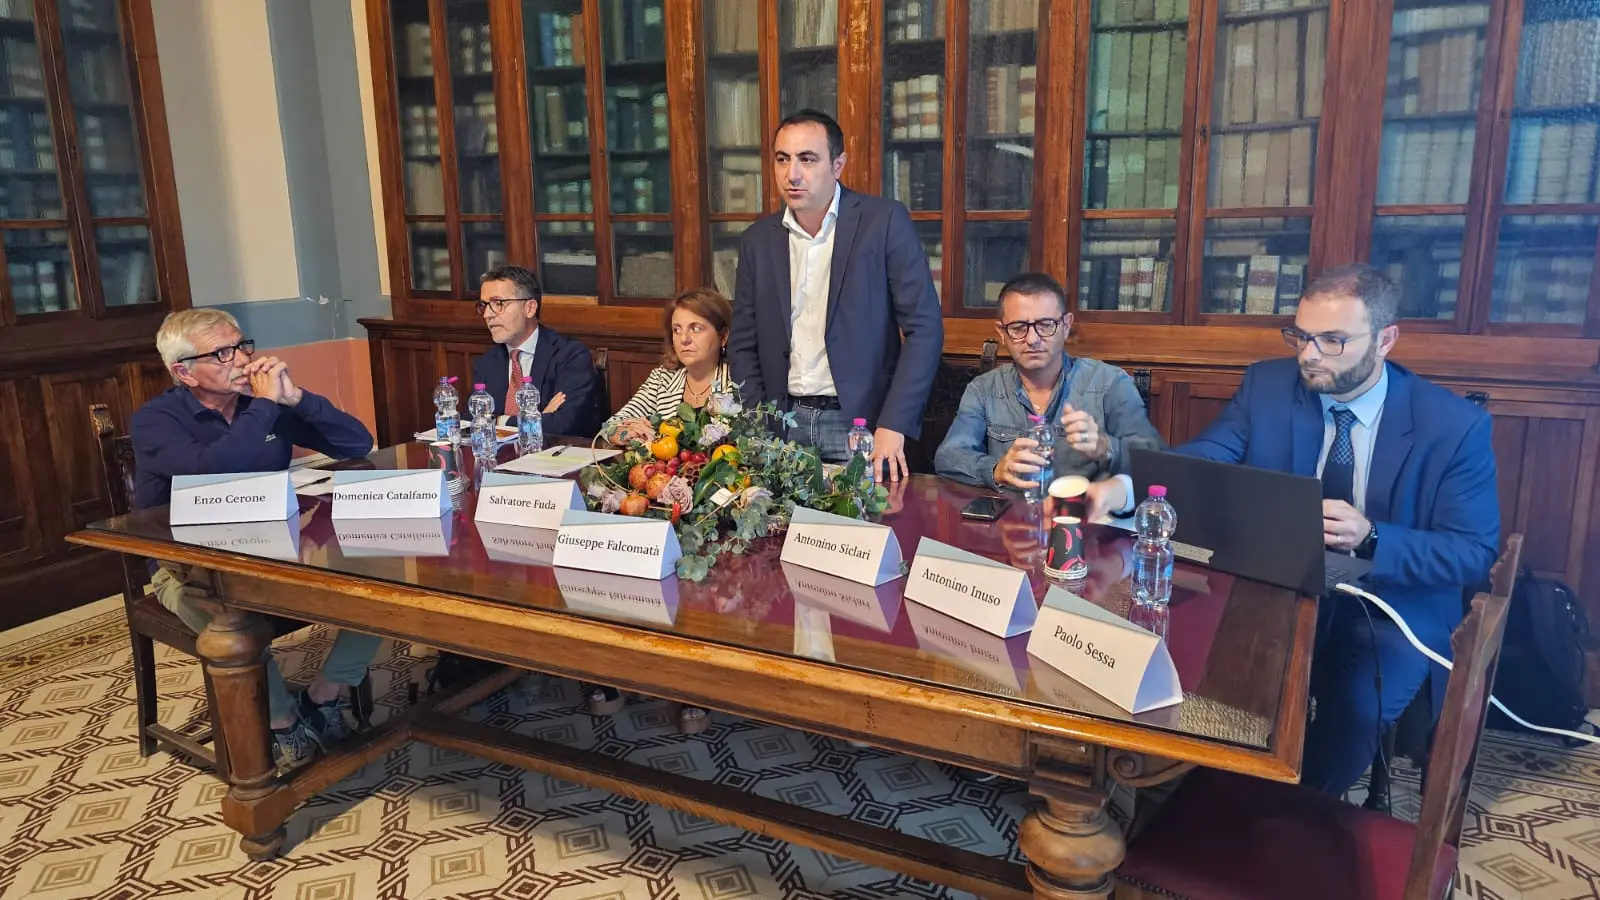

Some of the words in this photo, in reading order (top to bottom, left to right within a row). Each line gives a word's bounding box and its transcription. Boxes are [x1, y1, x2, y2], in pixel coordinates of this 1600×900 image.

[194, 495, 222, 505] Enzo
[225, 493, 266, 504] Cerone
[334, 491, 384, 501] Domenica
[386, 490, 438, 501] Catalfamo
[489, 495, 532, 508] Salvatore
[533, 499, 556, 511] Fuda
[558, 534, 604, 550] Giuseppe
[607, 539, 660, 556] Falcomatà
[794, 532, 837, 552] Antonino
[838, 543, 872, 560] Siclari
[922, 567, 968, 595] Antonino
[970, 585, 1001, 607] Inuso
[1054, 624, 1084, 652] Paolo
[1086, 641, 1116, 670] Sessa
